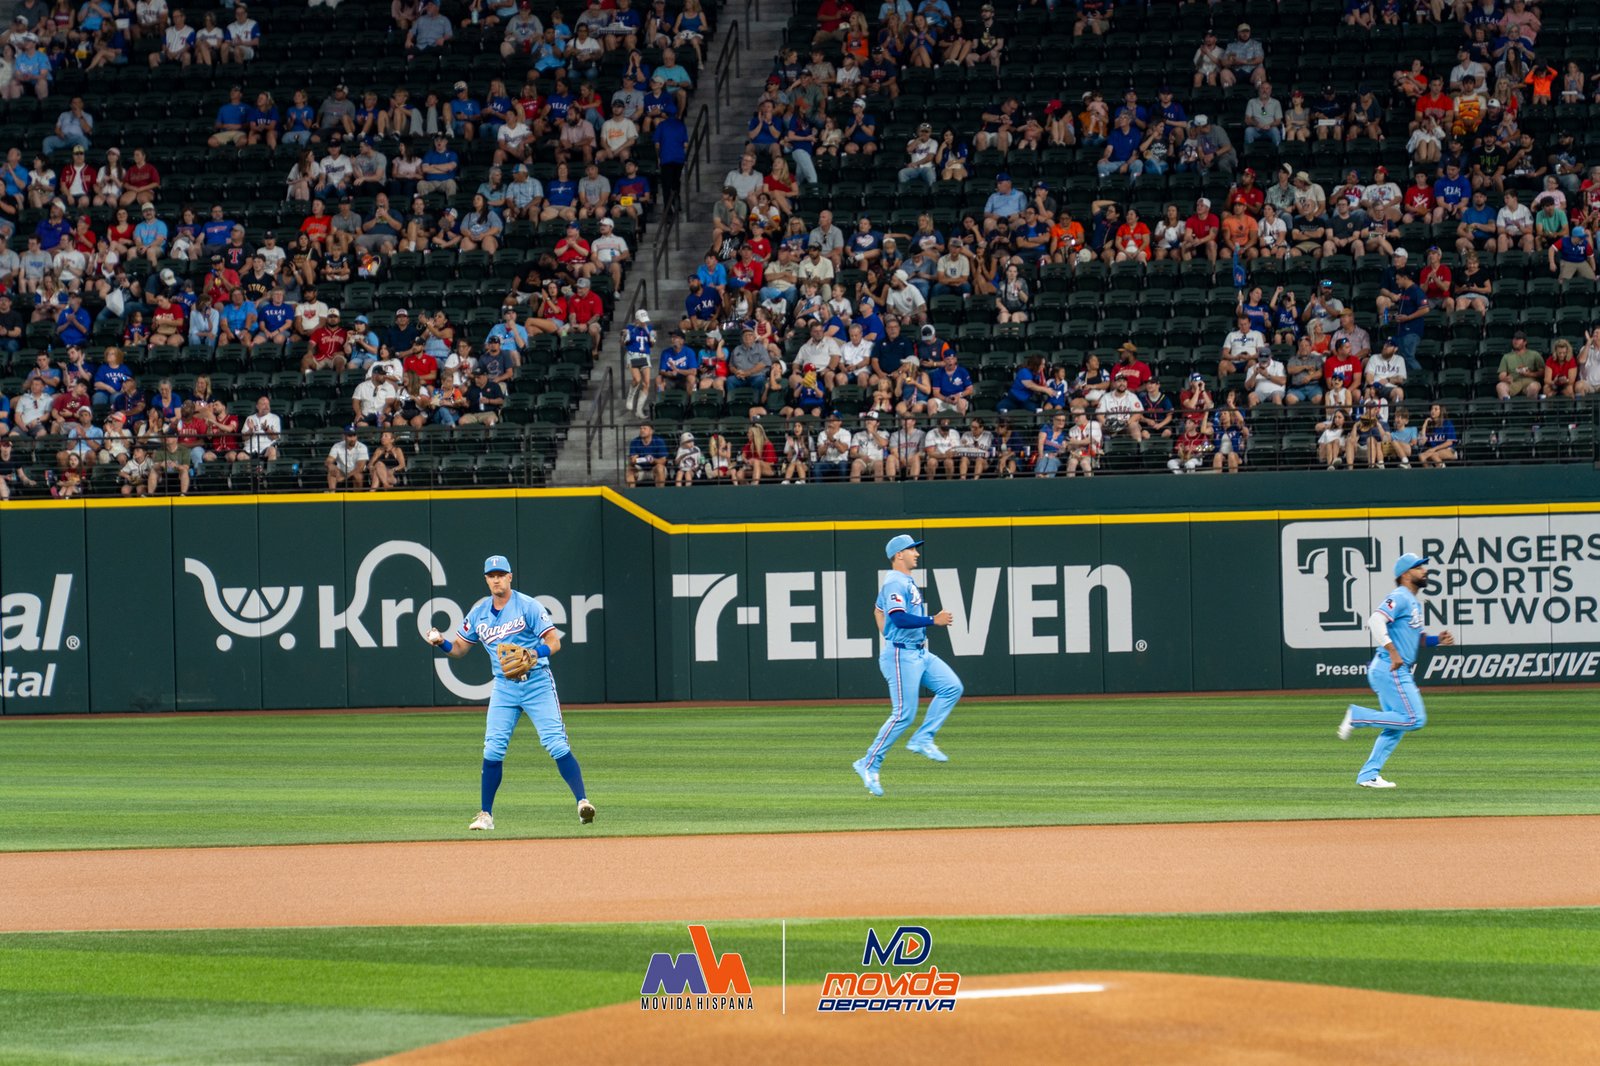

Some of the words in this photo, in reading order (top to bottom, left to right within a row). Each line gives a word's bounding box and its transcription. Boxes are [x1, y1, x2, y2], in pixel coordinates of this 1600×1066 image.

[228, 248, 242, 264] T
[635, 336, 648, 351] T
[491, 558, 498, 566] T
[1422, 533, 1600, 565] RANGERS
[1422, 565, 1574, 596] SPORTS
[476, 615, 526, 645] Rangers
[1424, 652, 1600, 679] PROGRESSIVE
[0, 663, 56, 697] tal
